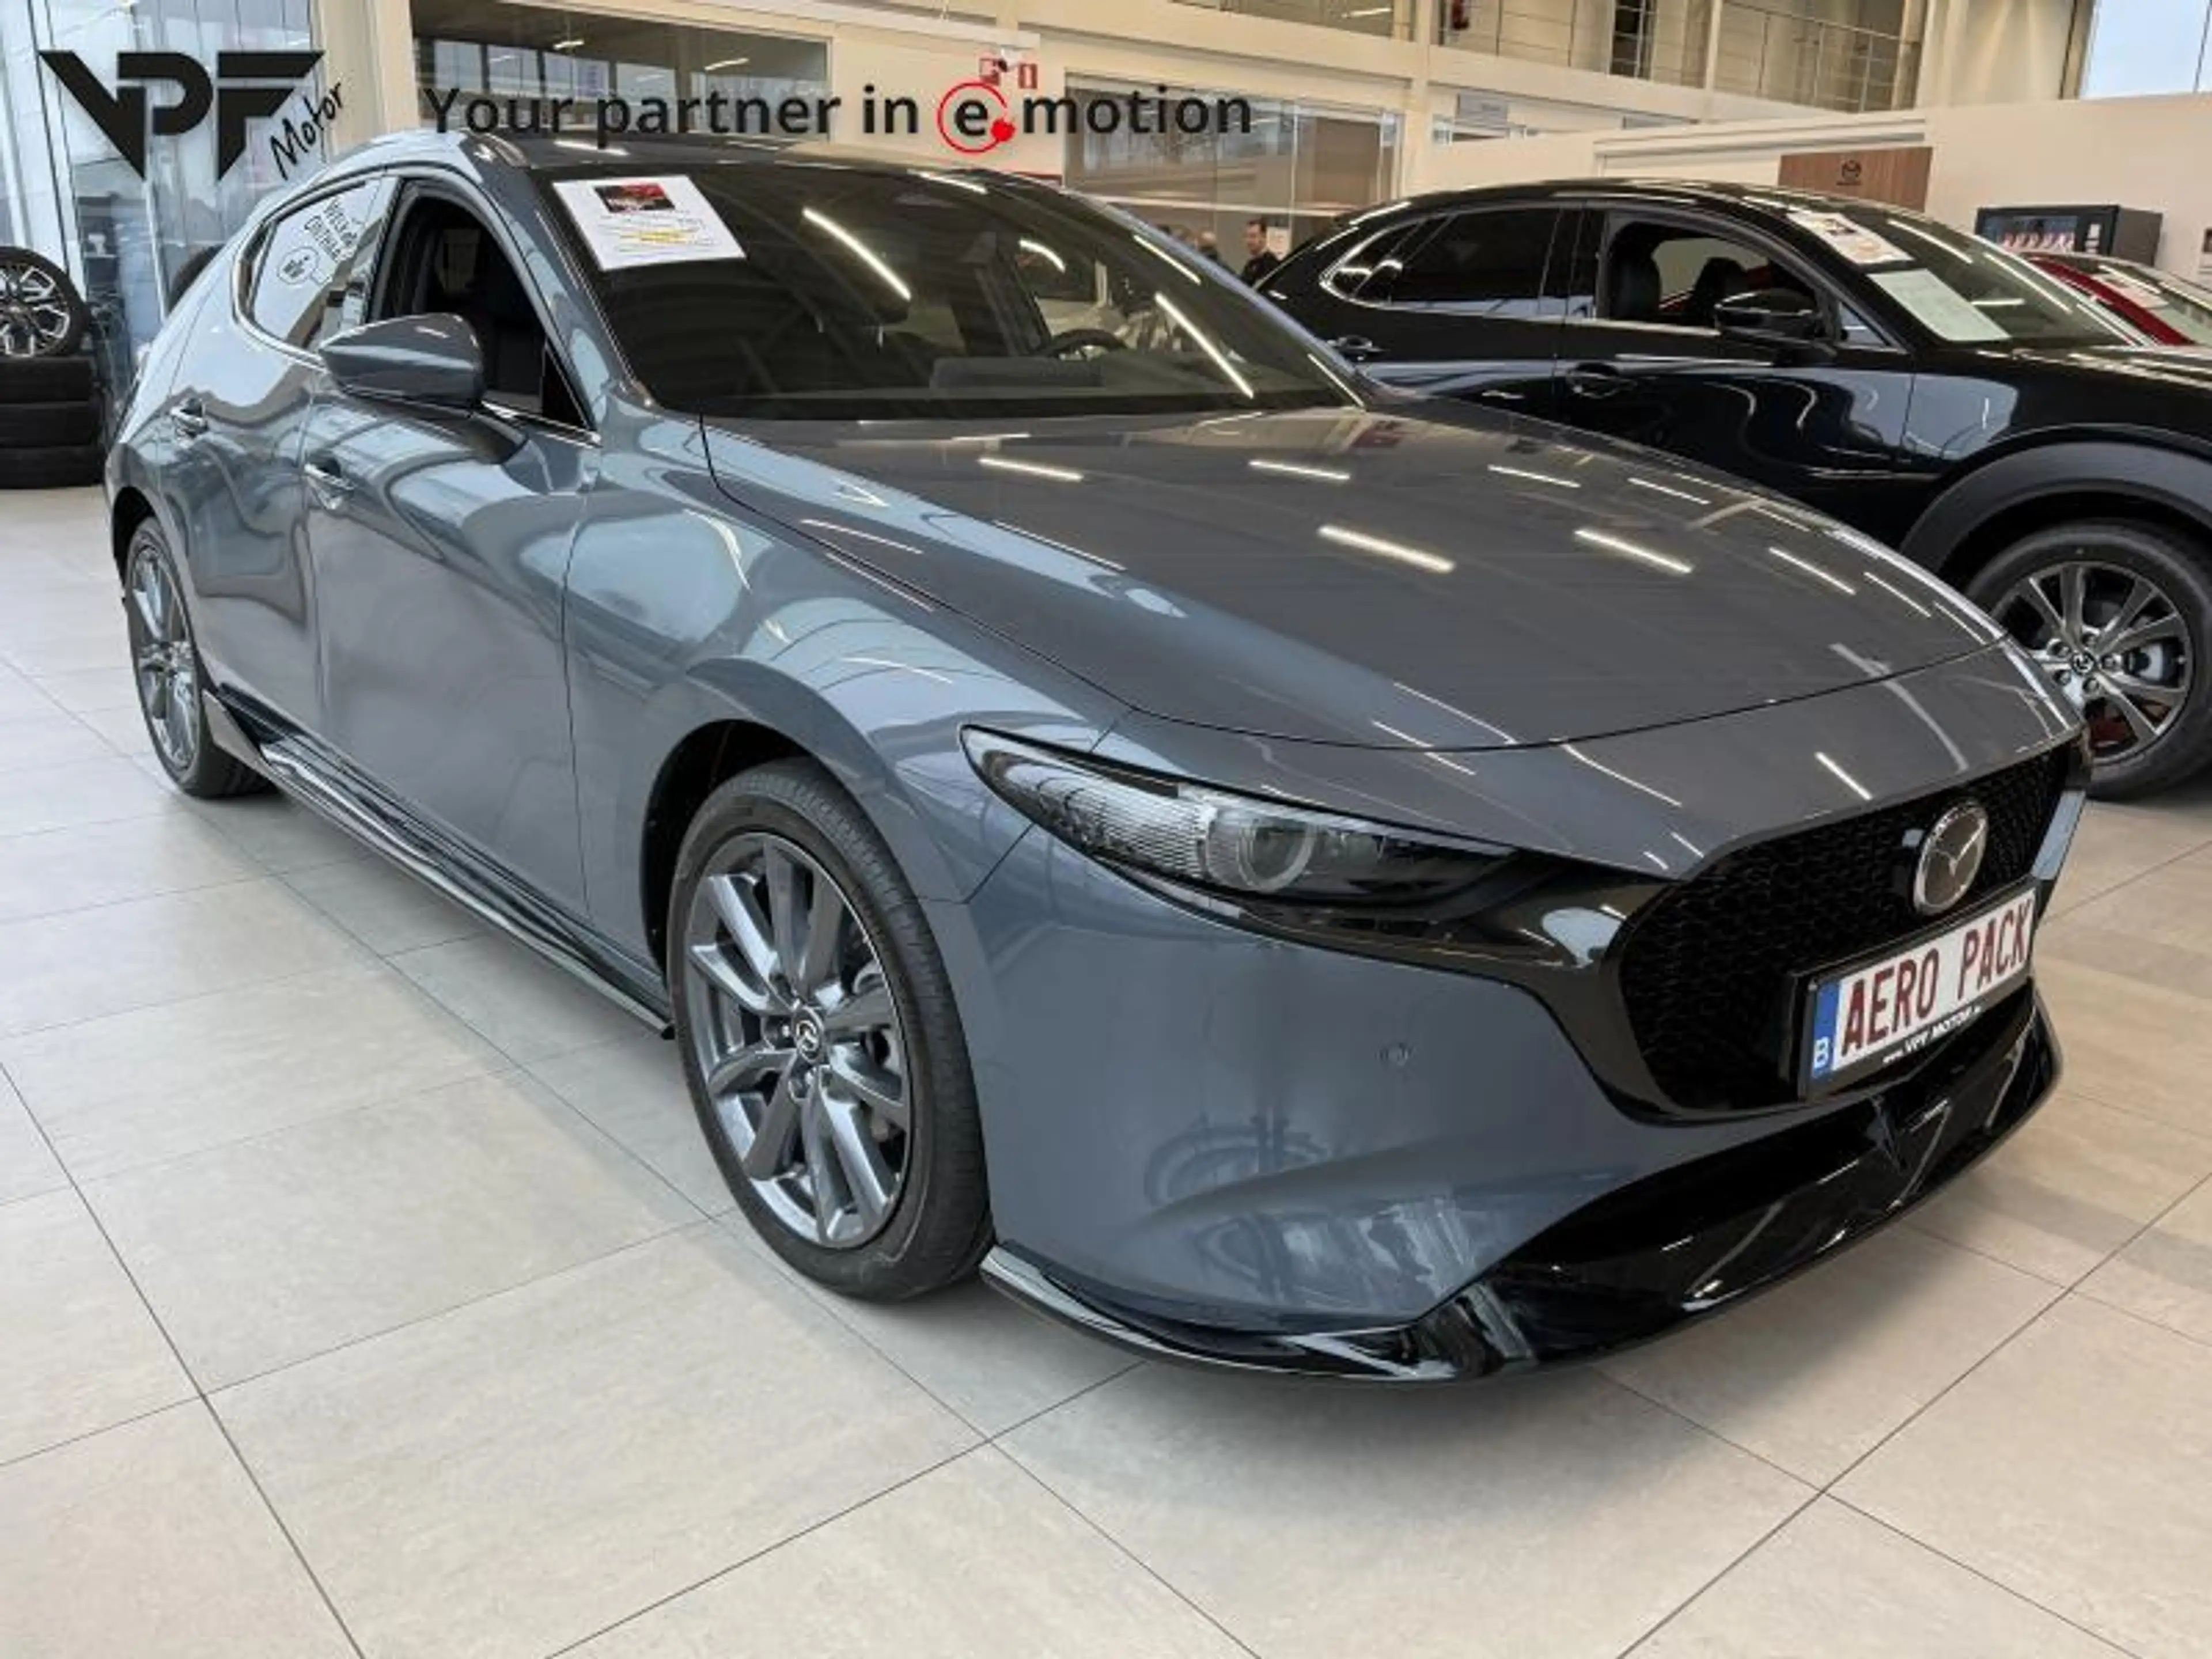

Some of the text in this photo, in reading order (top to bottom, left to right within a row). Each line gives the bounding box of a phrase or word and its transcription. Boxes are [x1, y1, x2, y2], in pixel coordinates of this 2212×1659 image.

[1843, 899, 2032, 1057] AERO PACK
[1813, 1036, 1830, 1070] B
